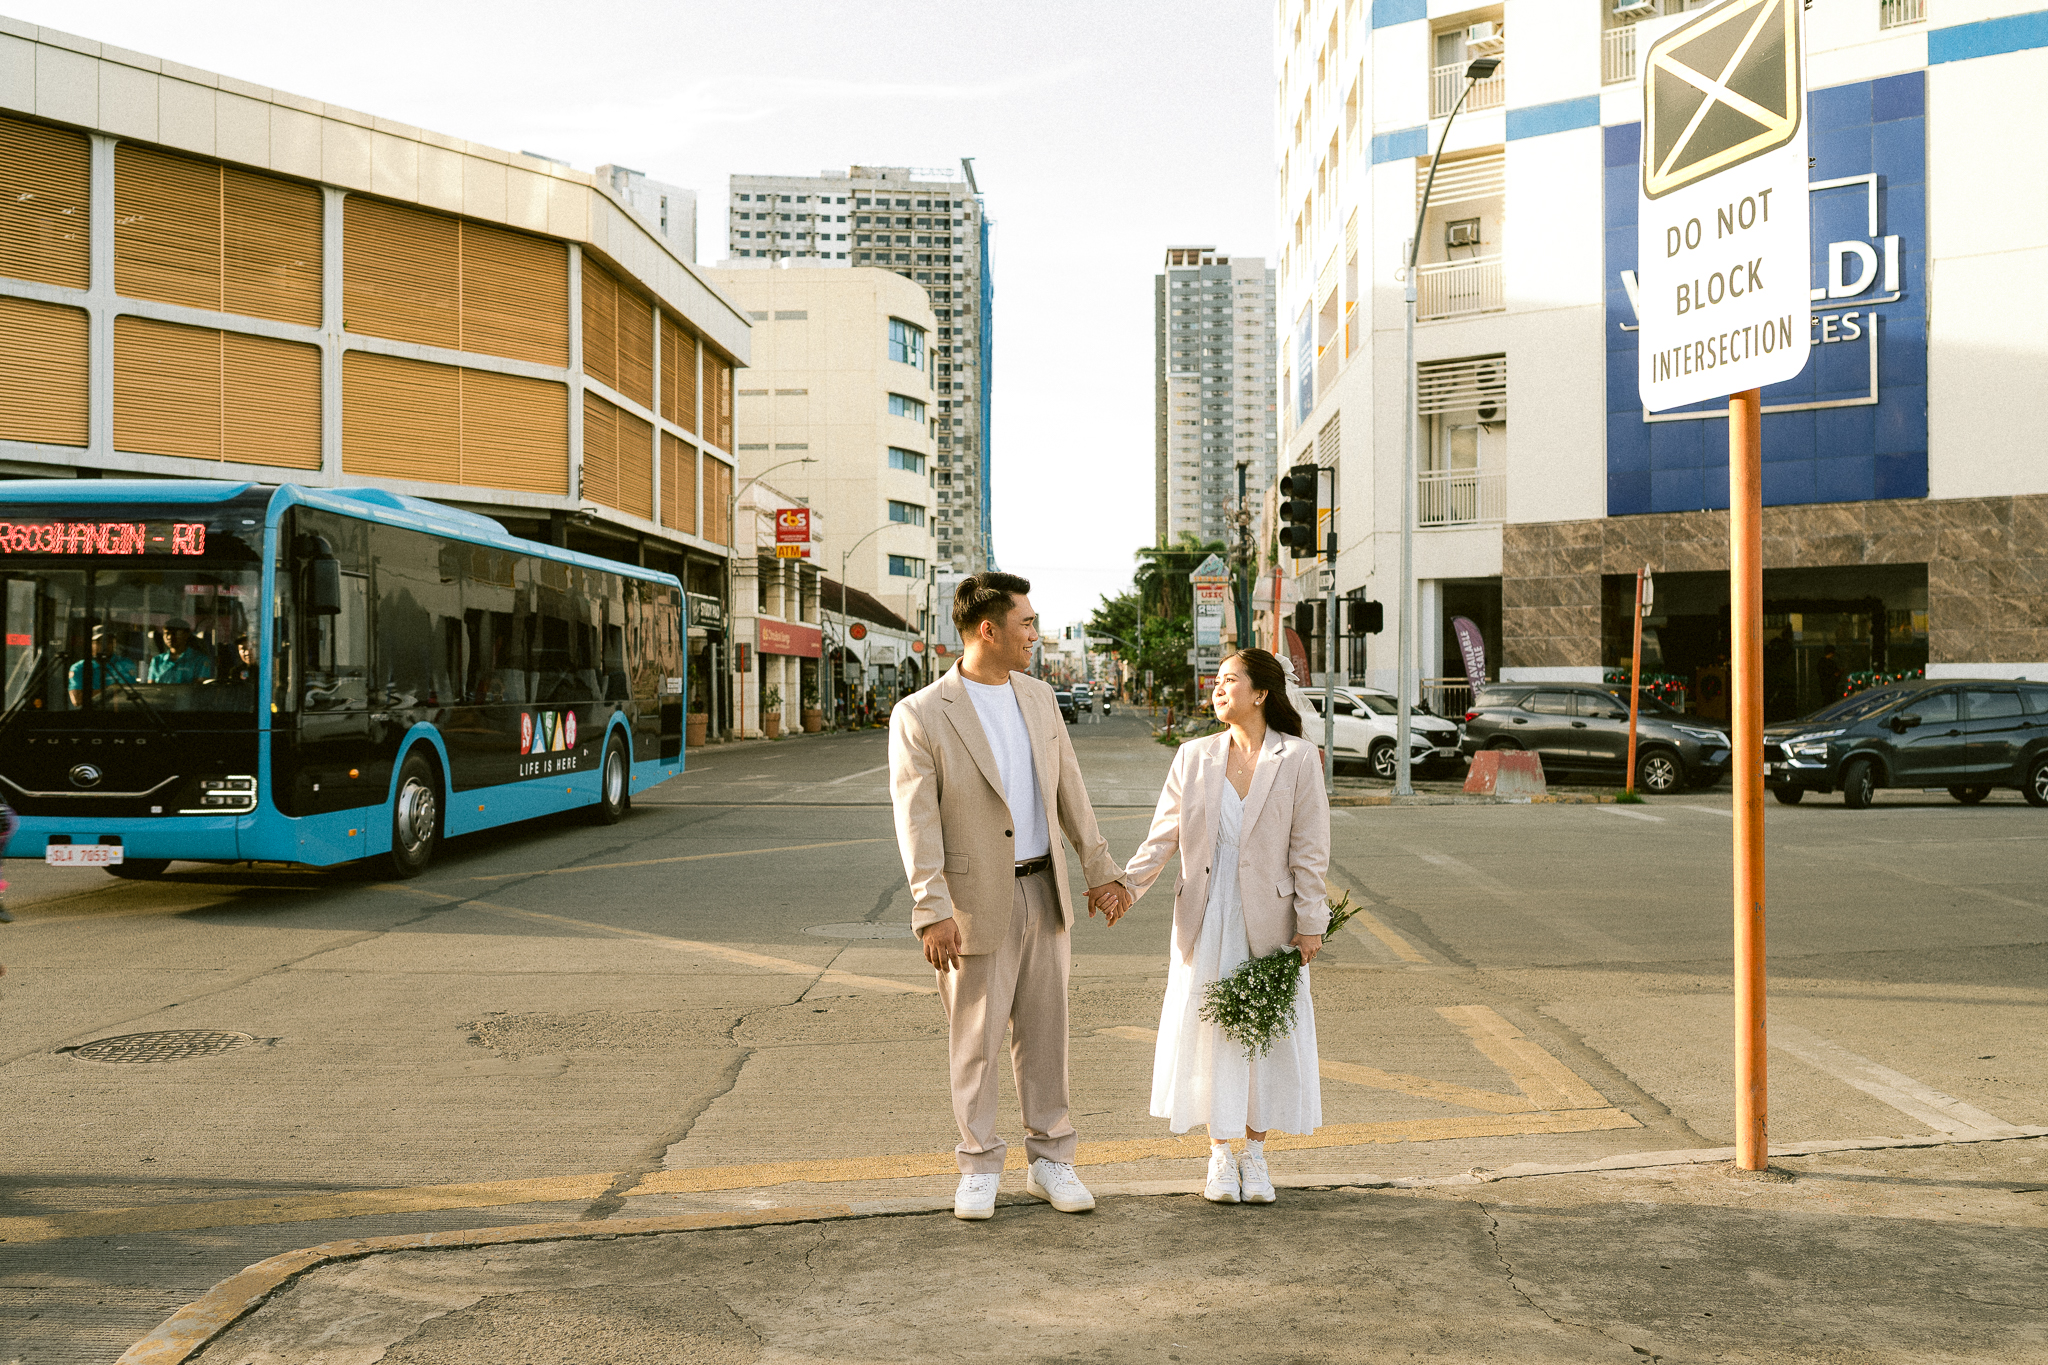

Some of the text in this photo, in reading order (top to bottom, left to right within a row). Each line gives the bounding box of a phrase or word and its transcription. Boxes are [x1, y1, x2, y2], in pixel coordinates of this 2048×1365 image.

[1666, 187, 1773, 258] DO NOT
[1676, 257, 1764, 316] BLOCK
[1652, 314, 1793, 384] INTERSECTION
[778, 545, 800, 557] ATM
[1460, 630, 1479, 678] AVAILABLE
[520, 710, 577, 755] DAVAO
[519, 756, 577, 777] LIFE IS HERE
